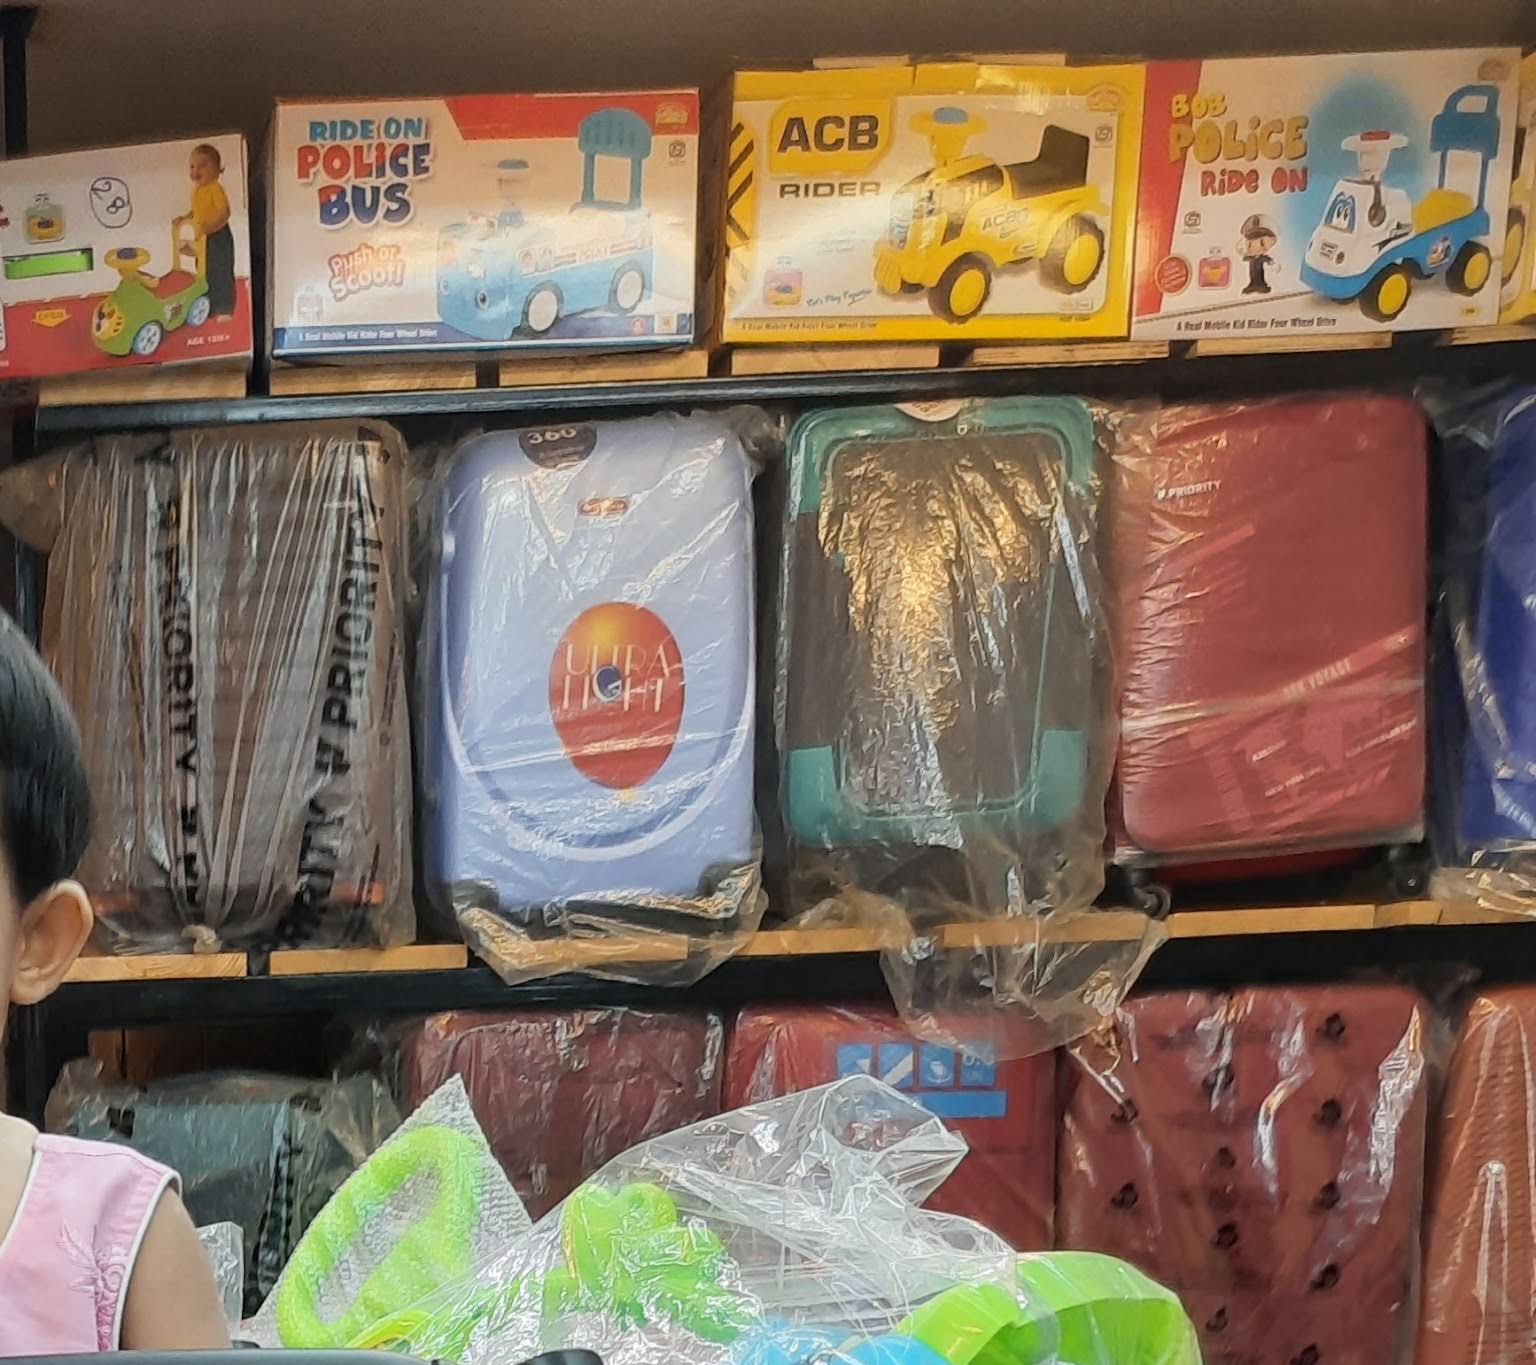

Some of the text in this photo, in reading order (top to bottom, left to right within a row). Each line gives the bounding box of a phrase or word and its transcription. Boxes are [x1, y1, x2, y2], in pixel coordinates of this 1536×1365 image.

[1170, 93, 1228, 119] BOB
[309, 117, 424, 142] RIDE ON
[777, 115, 880, 153] ACB
[779, 181, 882, 199] RIDER
[1270, 166, 1308, 194] ON
[317, 182, 413, 226] BUS
[526, 427, 577, 444] 360
[1168, 479, 1222, 500] PRIORITY
